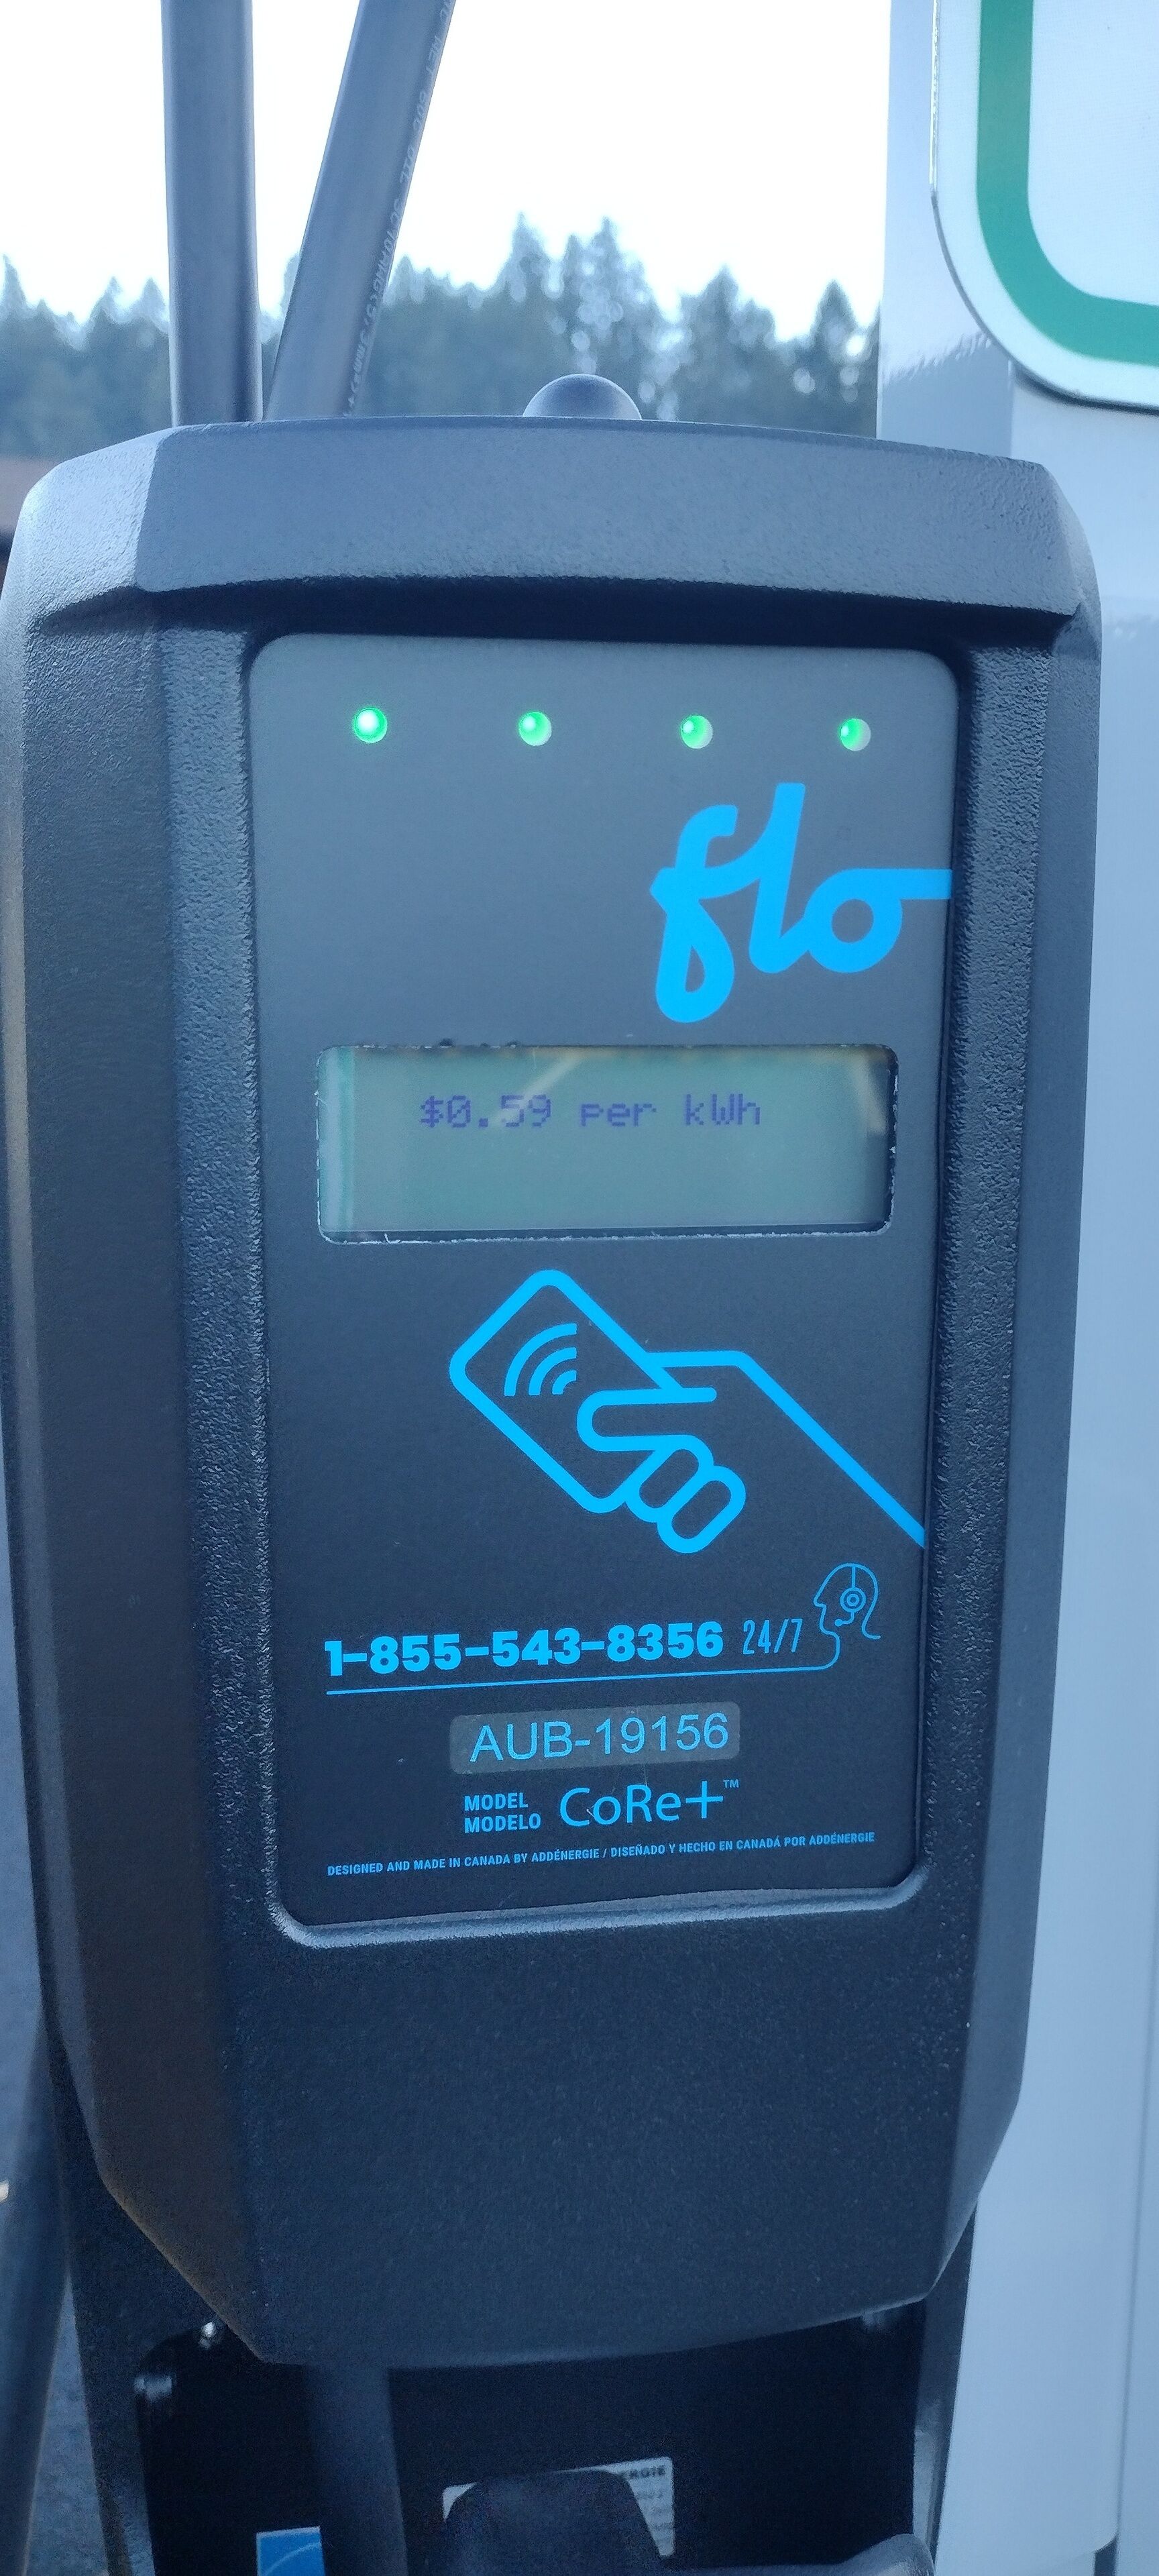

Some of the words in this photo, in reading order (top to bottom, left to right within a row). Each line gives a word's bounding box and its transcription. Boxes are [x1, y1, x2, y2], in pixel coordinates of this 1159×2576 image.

[399, 144, 416, 184] OIL
[649, 781, 953, 1024] flo
[421, 1094, 552, 1128] $0.59
[581, 1102, 657, 1128] per
[685, 1093, 761, 1126] kWh
[324, 1620, 724, 1677] 1-855-543-8356
[741, 1617, 804, 1656] 24/7
[469, 1711, 730, 1763] AUB-19156
[464, 1792, 529, 1811] MODEL
[464, 1813, 542, 1834] MODELO
[327, 1863, 384, 1876] DESIGNED
[386, 1861, 410, 1872] AND
[413, 1858, 445, 1870] MADE
[449, 1857, 461, 1868] IN
[464, 1854, 510, 1867] CANADA
[514, 1853, 529, 1864] BY
[531, 1847, 600, 1863] ADDÉNERGIE
[603, 1847, 608, 1858] /
[610, 1843, 666, 1858] DISEÑADO
[668, 1843, 675, 1854] Y
[679, 1841, 716, 1854] HECHO
[719, 1840, 733, 1851] EN
[736, 1835, 781, 1850] CANADÁ
[783, 1835, 806, 1847] POR
[809, 1831, 876, 1845] ADDÉNERGIE
